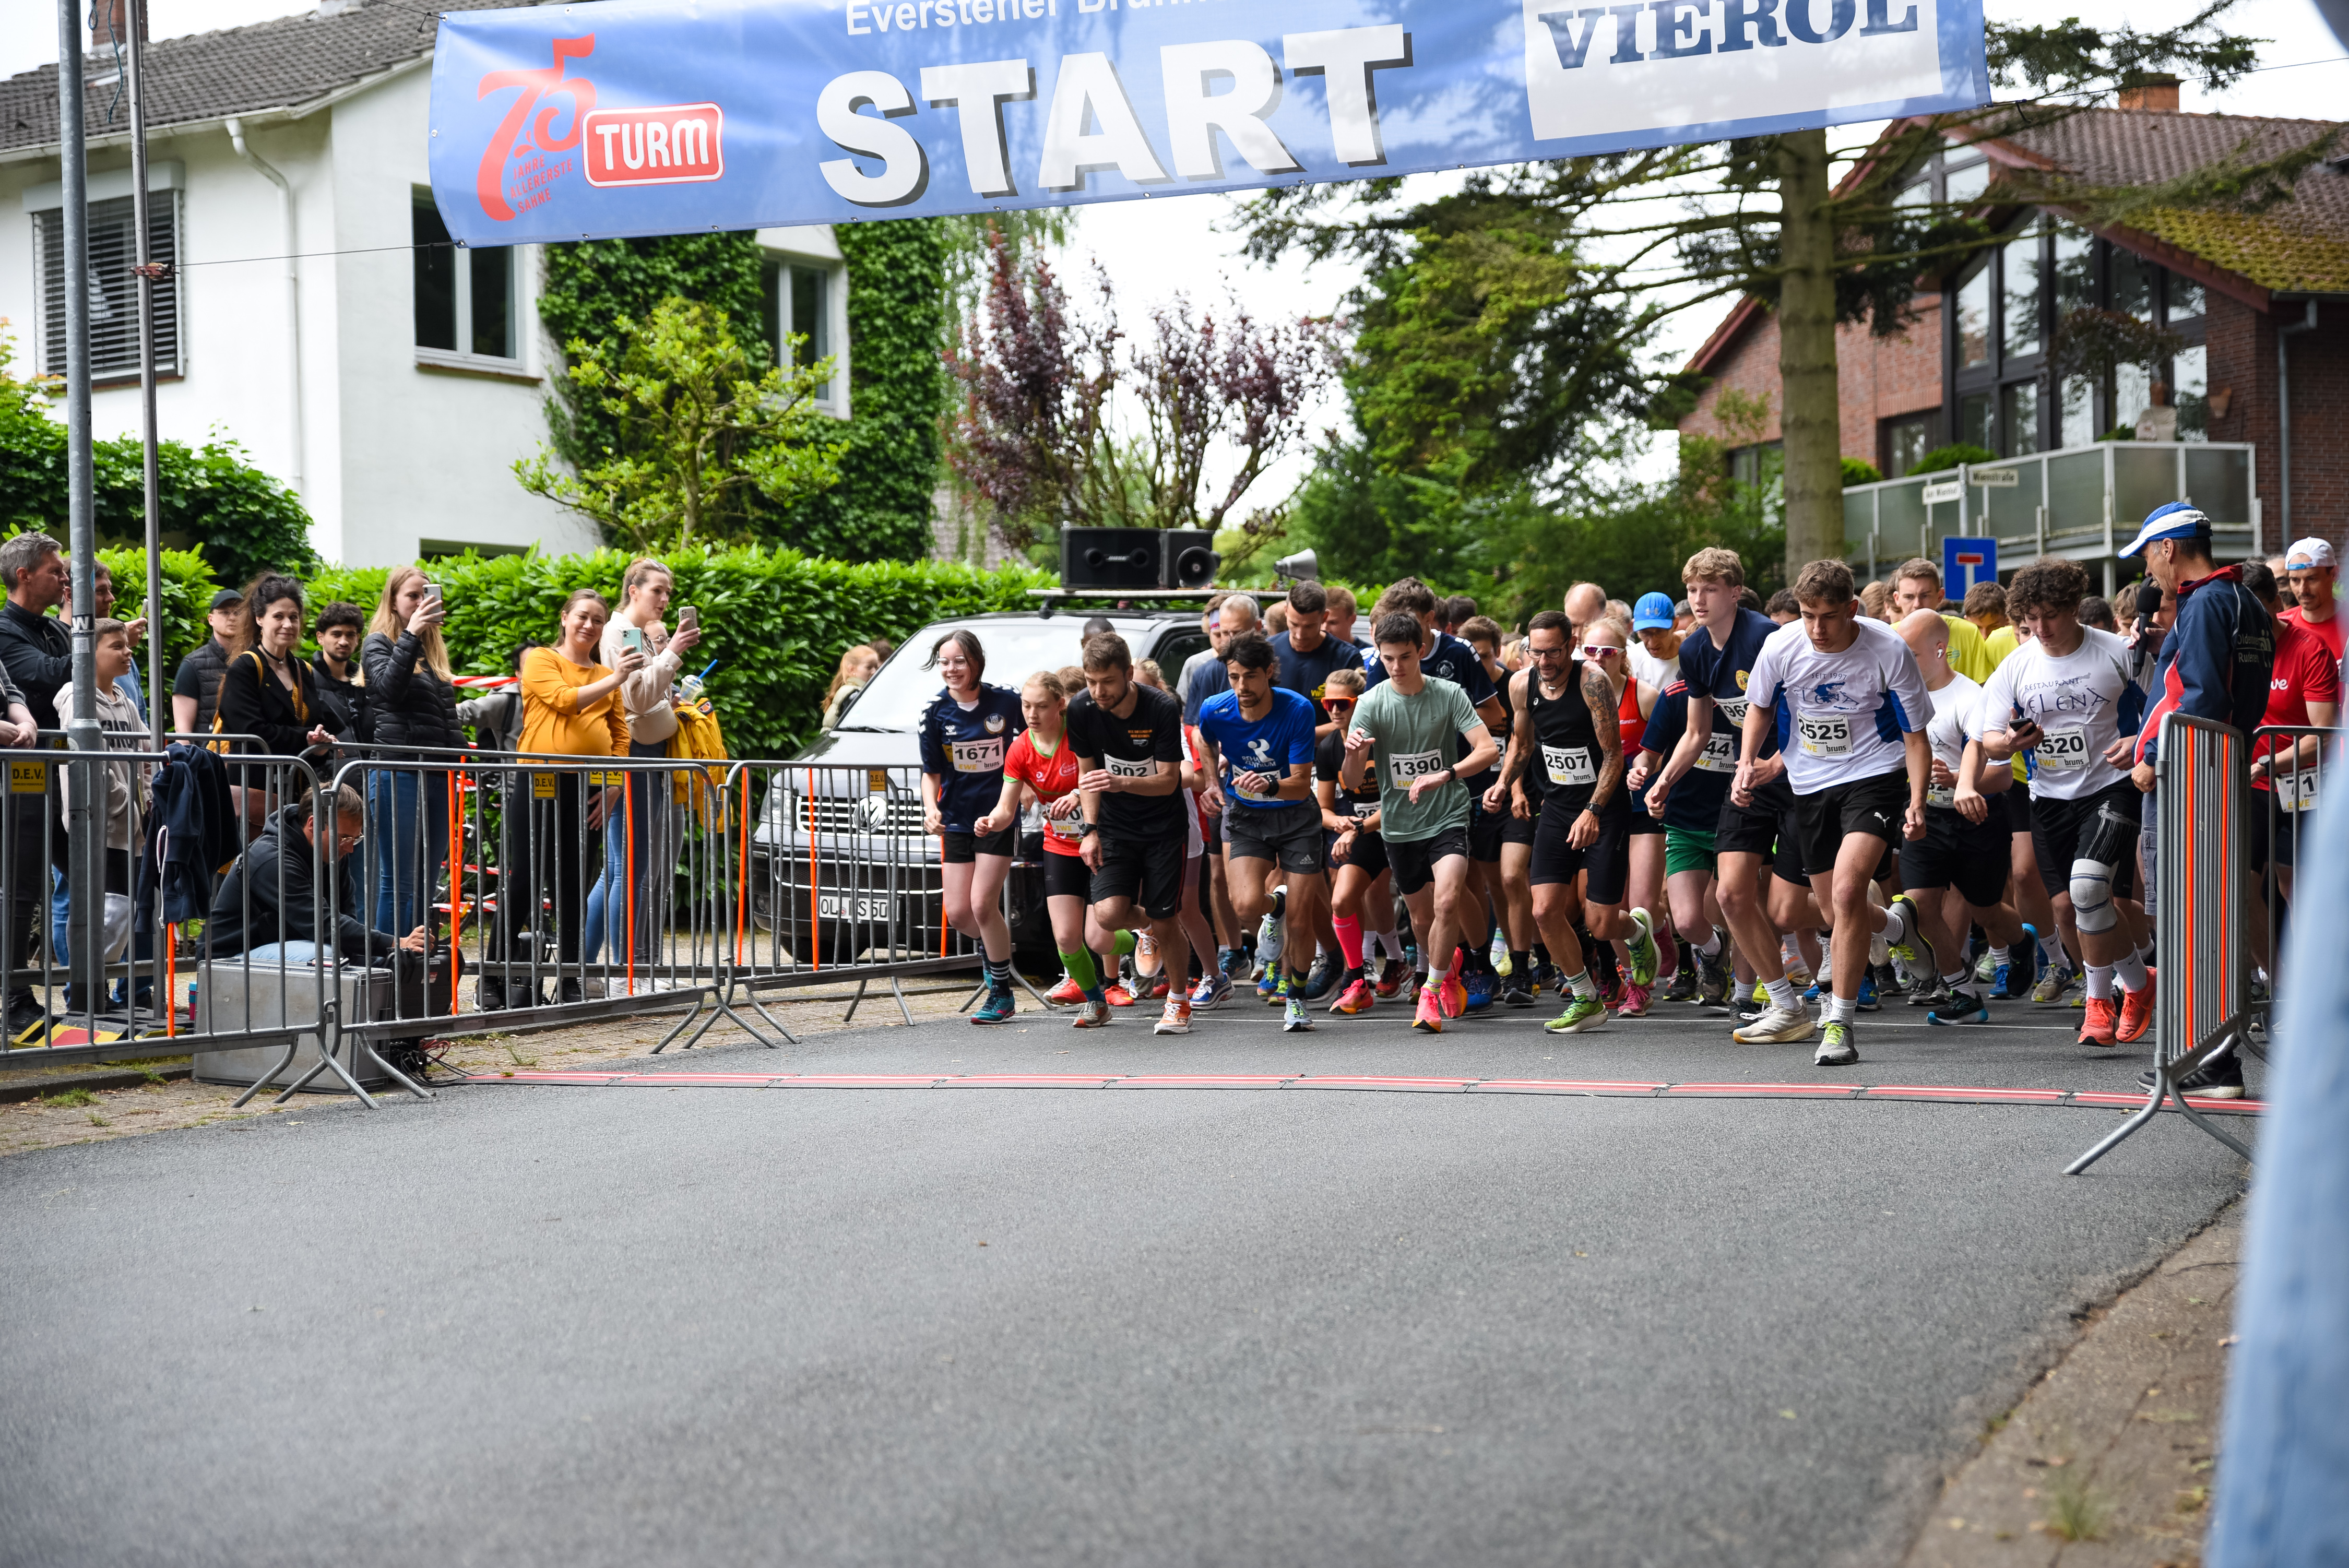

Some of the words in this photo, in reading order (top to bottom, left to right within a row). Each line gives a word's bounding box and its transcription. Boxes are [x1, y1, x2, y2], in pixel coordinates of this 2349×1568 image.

[1538, 0, 1918, 69] VIEROL
[816, 23, 1409, 205] START
[596, 118, 710, 170] TURM
[513, 154, 545, 181] JAHRE
[510, 158, 573, 199] ALLERERSTE
[517, 188, 552, 214] SAHNE
[2024, 677, 2080, 692] RESTAURANT
[2028, 687, 2111, 714] ELENA
[1798, 718, 1848, 740] 2525
[954, 744, 1000, 760] 1671
[1803, 741, 1818, 752] EWE
[1392, 757, 1441, 775] 1390
[1545, 753, 1588, 770] 2507
[2039, 758, 2057, 767] EWE
[13, 768, 44, 779] D.E.V.
[1111, 764, 1148, 777] 902
[1552, 773, 1567, 781] EWE
[535, 778, 554, 787] D.E.V.
[1238, 790, 1255, 798] EWE
[821, 898, 838, 915] OL
